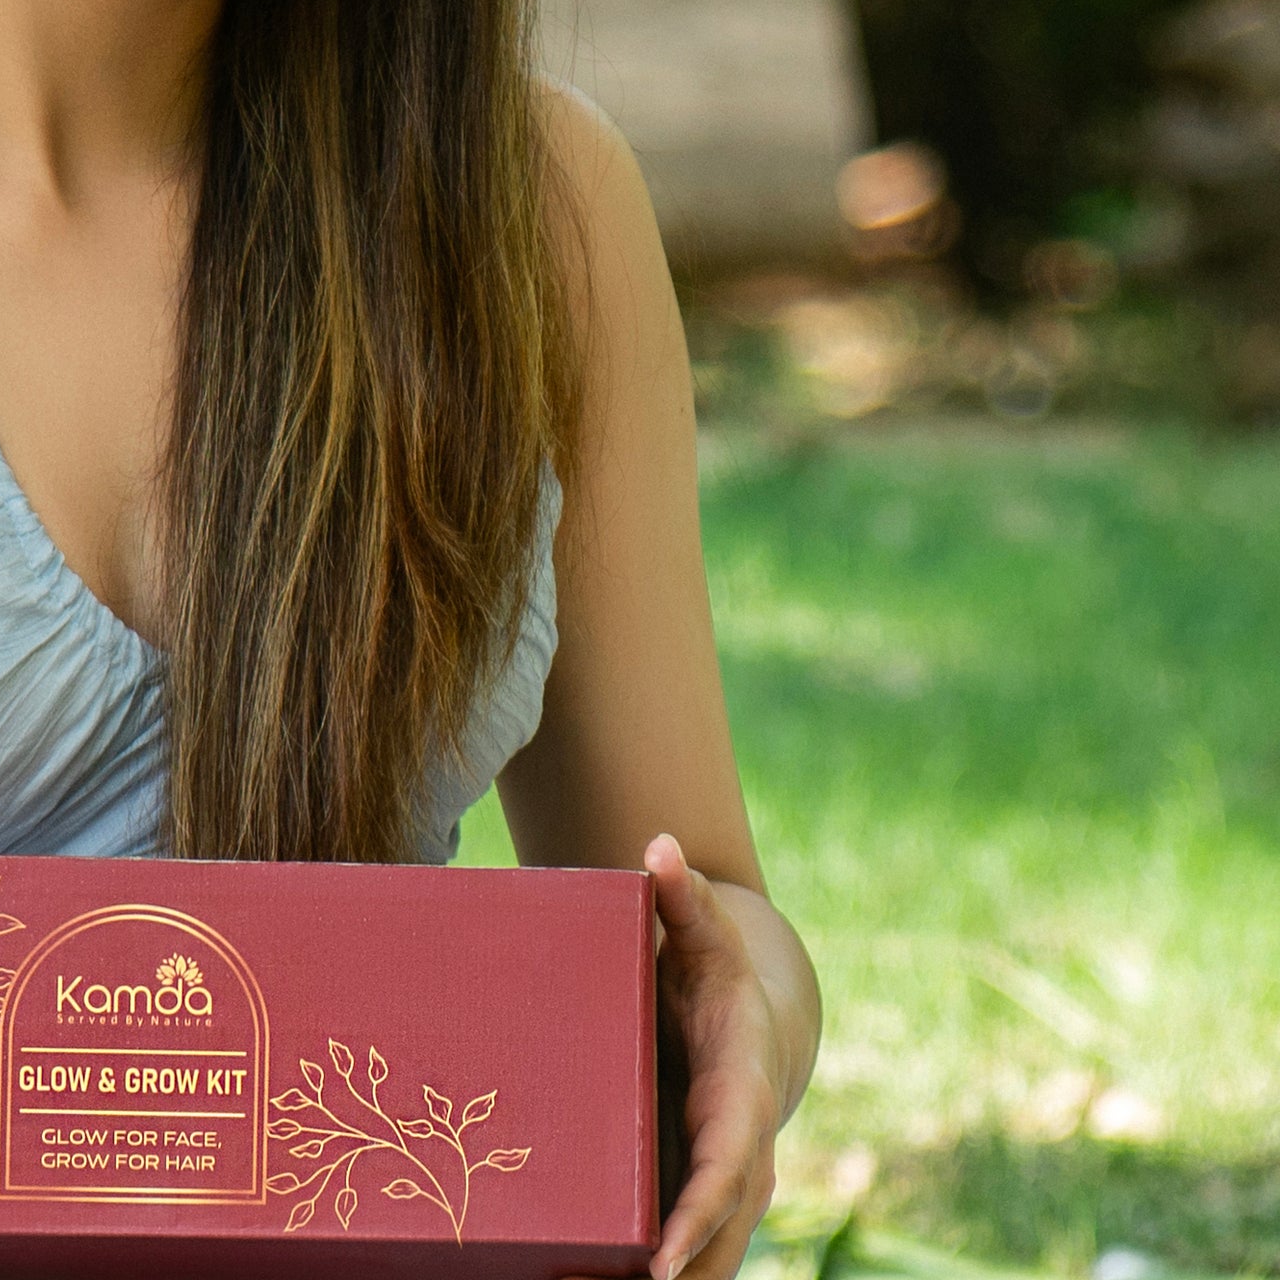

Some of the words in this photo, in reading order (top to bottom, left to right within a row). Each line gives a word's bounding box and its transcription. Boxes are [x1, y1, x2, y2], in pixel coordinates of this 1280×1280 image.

[57, 974, 212, 1015] Kamda
[56, 1013, 118, 1025] Served
[125, 1015, 144, 1027] By
[151, 1015, 212, 1027] Nature
[19, 1065, 91, 1092] GLOW
[98, 1067, 116, 1092] &
[124, 1068, 199, 1094] GROW
[207, 1069, 248, 1096] KIT
[41, 1128, 108, 1146] GLOW
[113, 1130, 159, 1147] FOR
[163, 1131, 221, 1149] FACE,
[41, 1153, 110, 1170] GROW
[115, 1154, 160, 1170] FOR
[165, 1155, 216, 1171] HAIR
